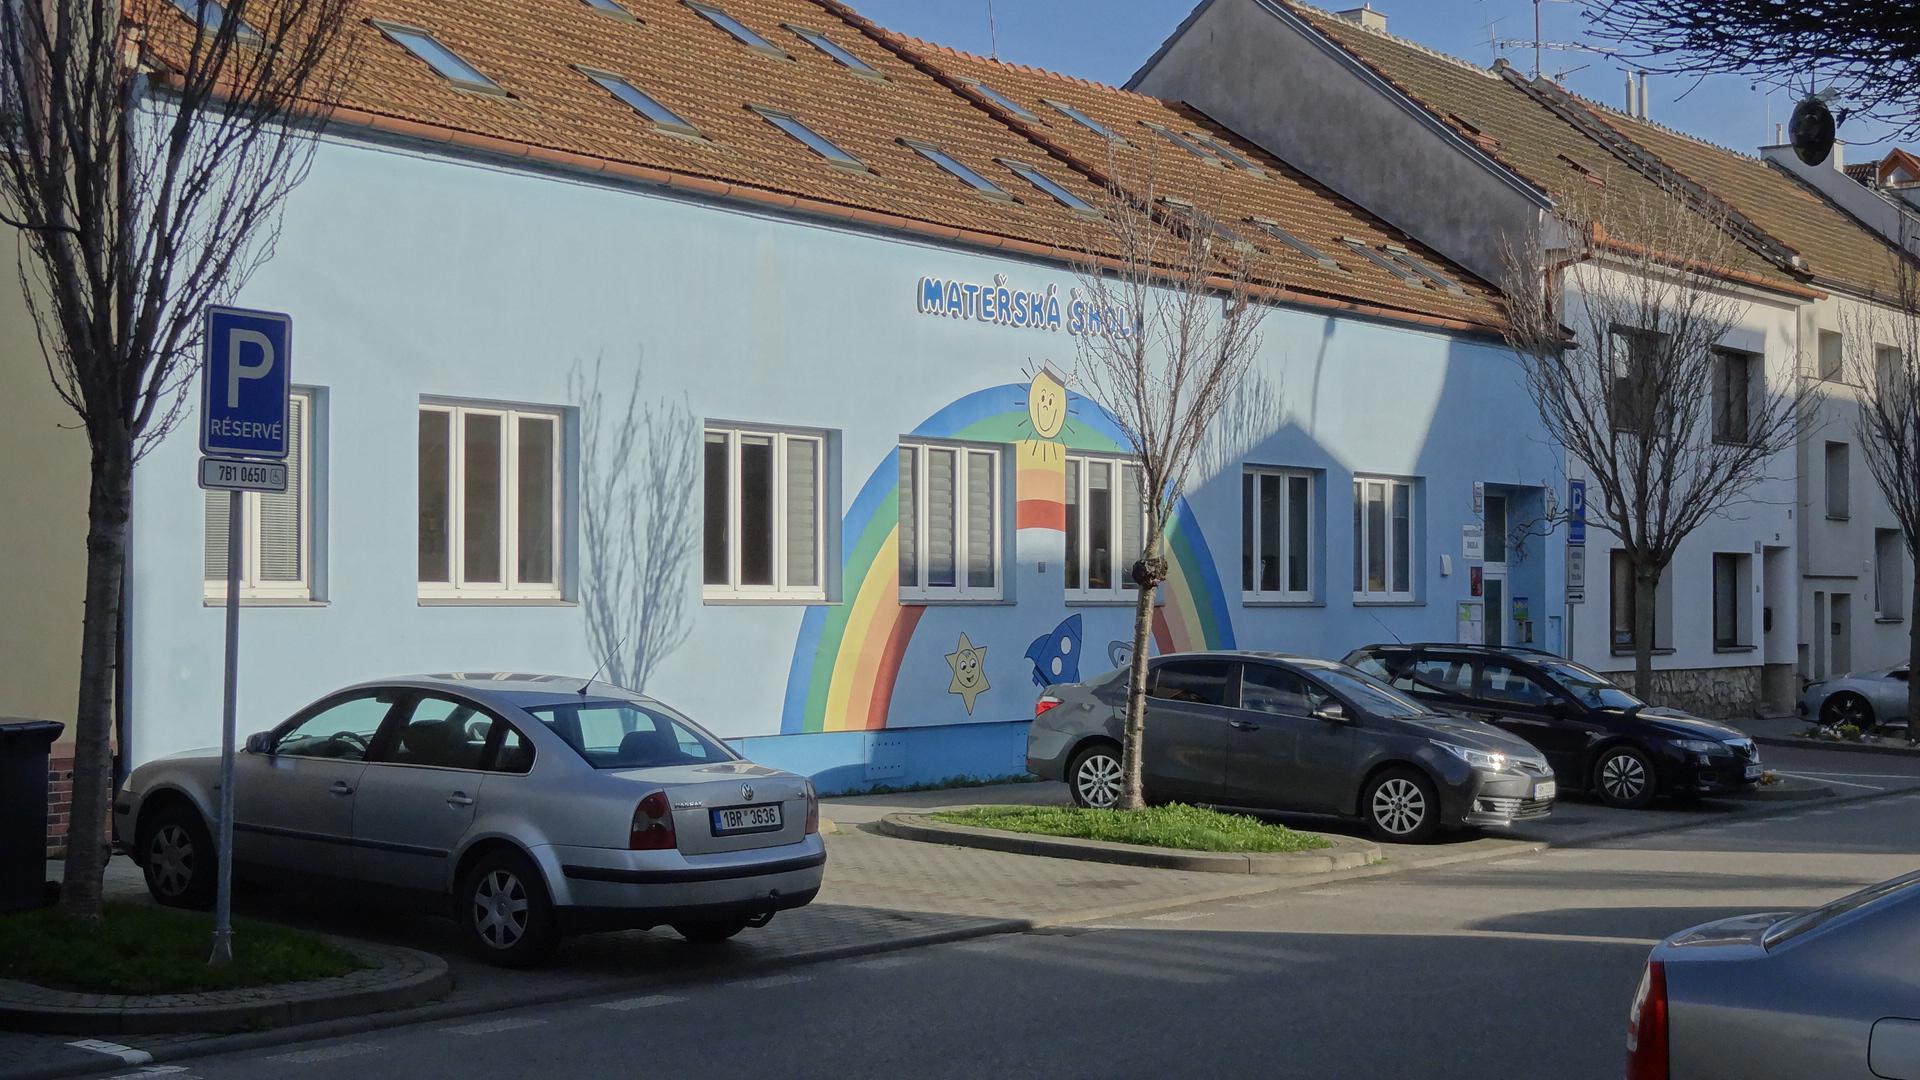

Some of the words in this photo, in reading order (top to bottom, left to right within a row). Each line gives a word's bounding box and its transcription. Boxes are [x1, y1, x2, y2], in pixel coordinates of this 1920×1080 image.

[918, 274, 1061, 332] MATEŘSKÁ
[228, 328, 275, 408] P
[210, 415, 282, 440] RÉSERVÉ
[219, 464, 237, 481] 7B1
[241, 466, 267, 483] 0650
[723, 811, 744, 828] 1BR
[750, 807, 776, 825] 3636
